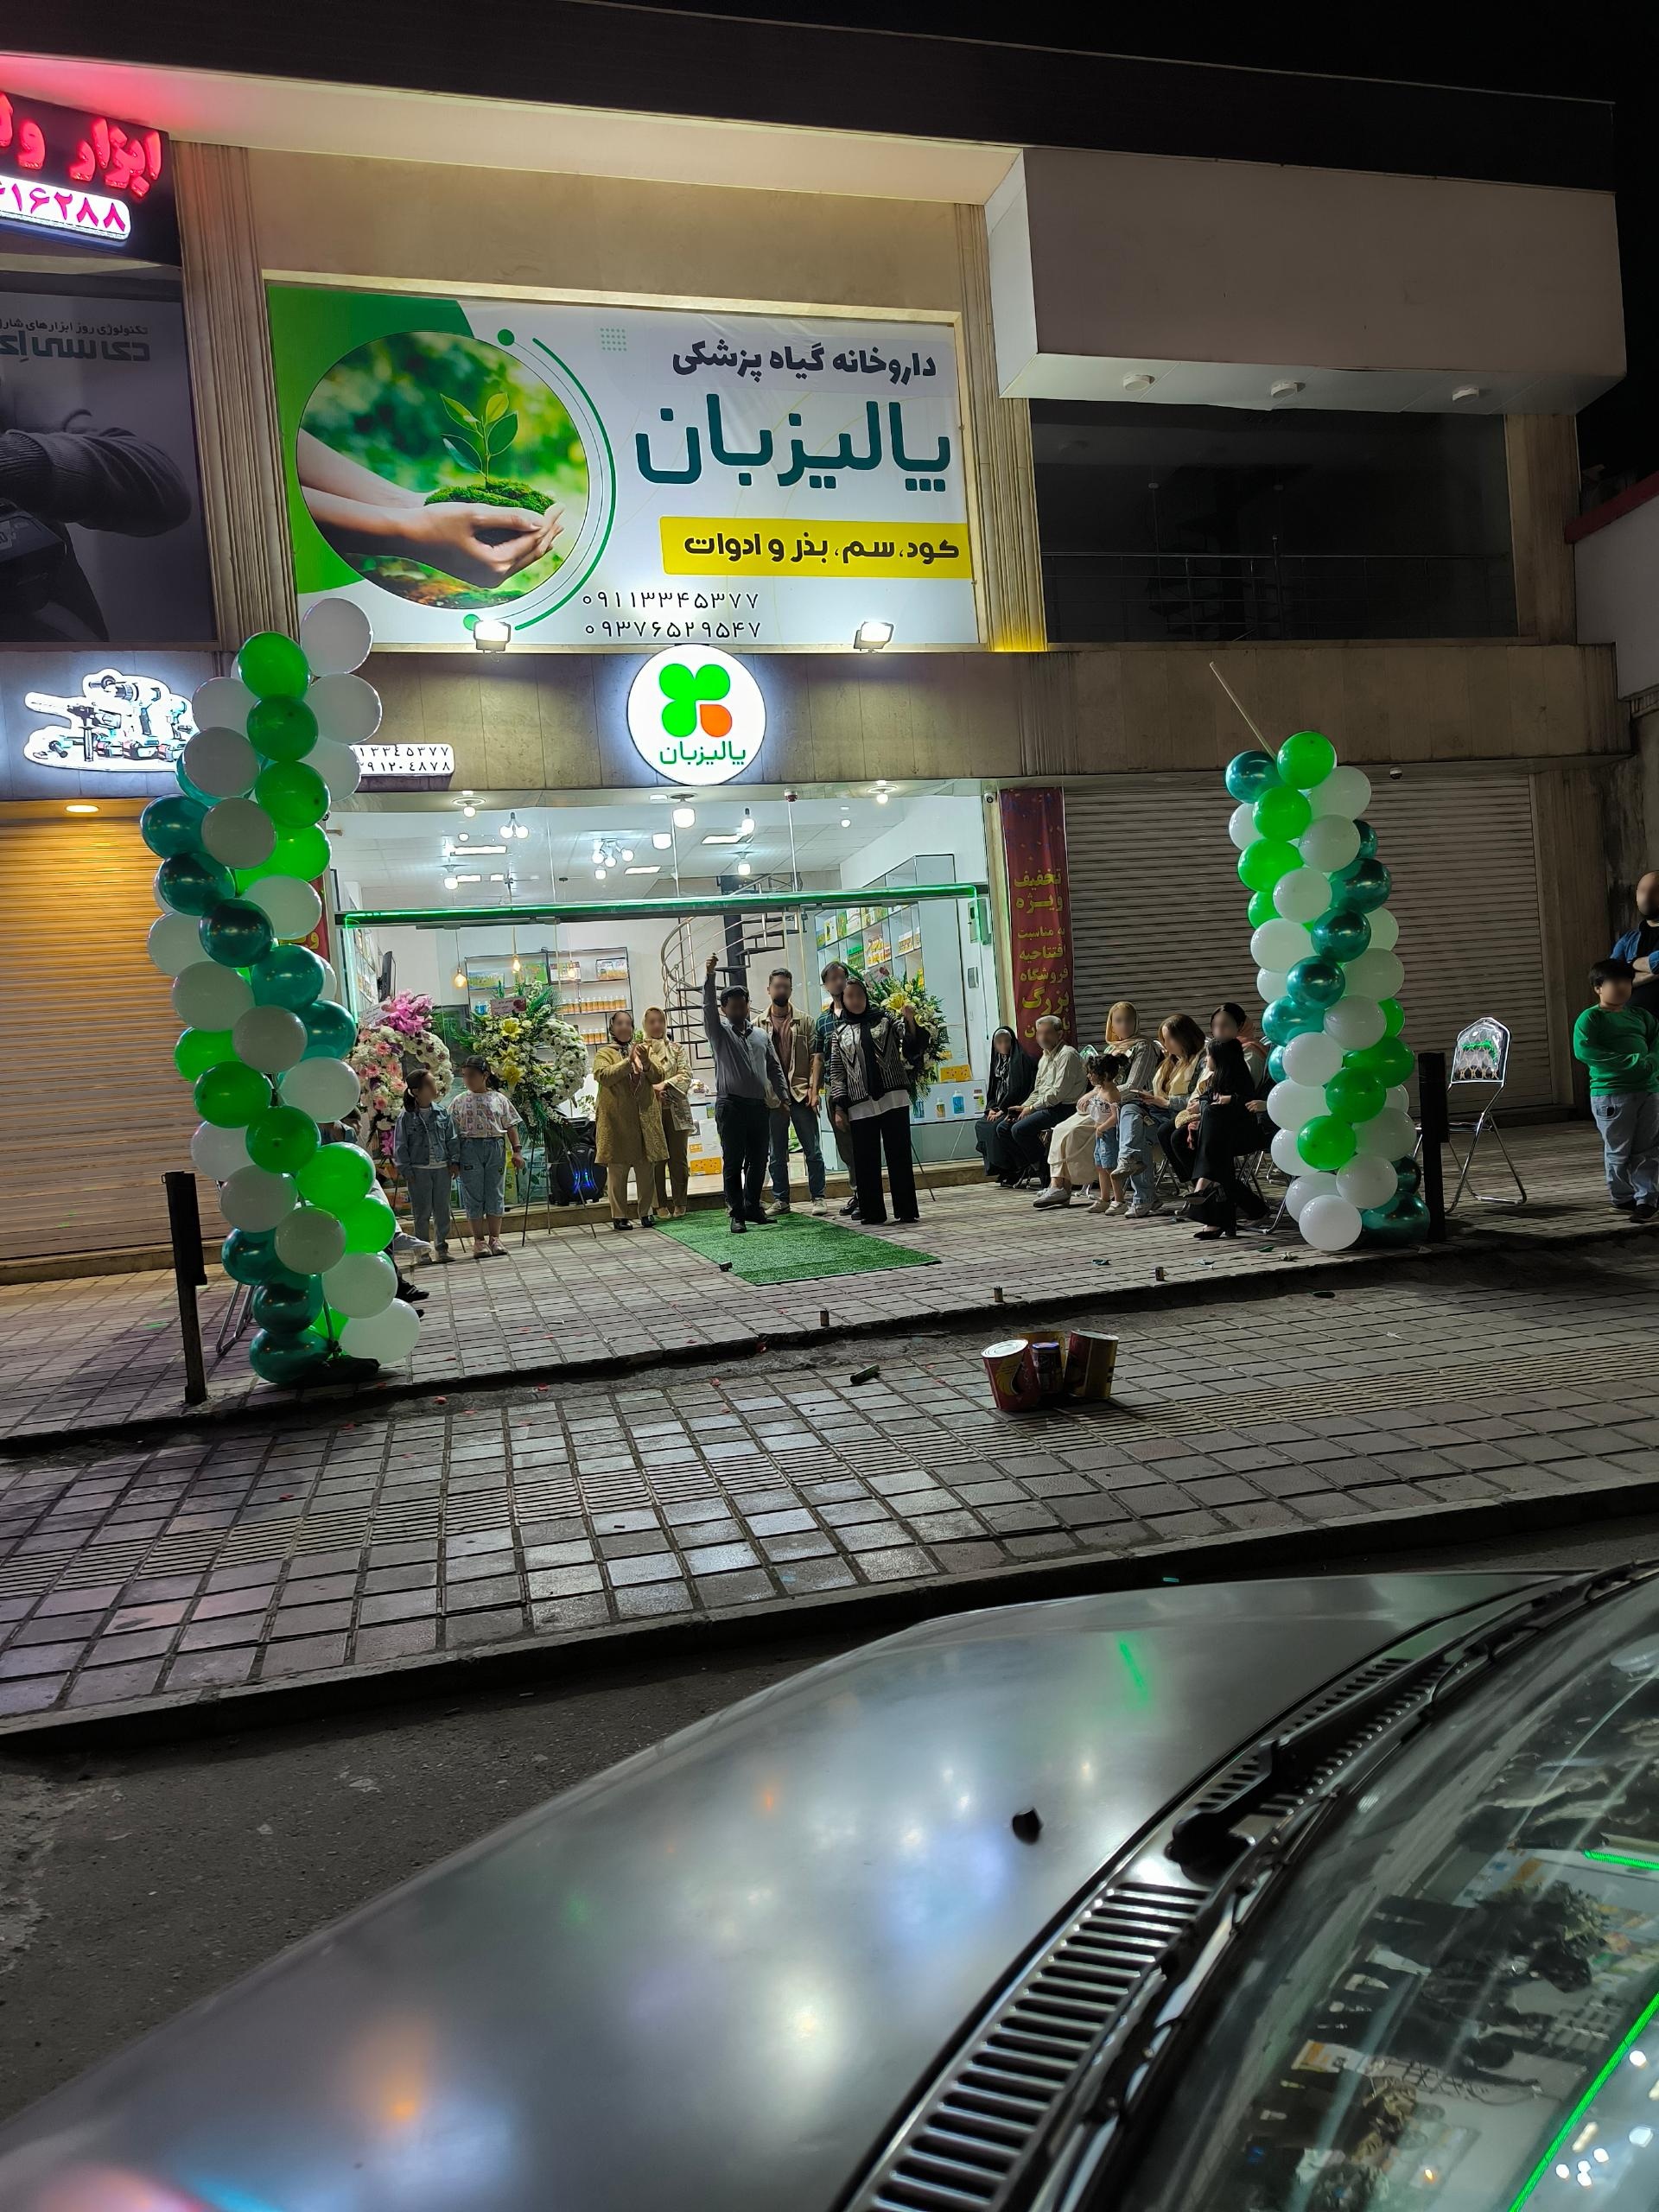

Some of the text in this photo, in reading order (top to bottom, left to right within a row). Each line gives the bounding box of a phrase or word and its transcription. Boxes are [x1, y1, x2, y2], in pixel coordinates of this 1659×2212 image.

[68, 118, 162, 198] ابزار
[76, 322, 94, 334] روز
[97, 323, 149, 336] تکنولوژی
[673, 339, 937, 385] داروخانه گیاه پزشکی
[635, 393, 950, 492] پالیزبان
[684, 532, 761, 562] ادوات
[768, 539, 785, 563] و
[791, 532, 828, 563] بذر
[582, 591, 759, 609] ۰۹۱۱۳۳۴۵۳۷۷
[585, 620, 760, 639] ۰۹۳۷۶۵۲۹۵۴۷
[659, 741, 746, 766] پالیزبان
[1014, 868, 1062, 891] تخفیف
[1015, 893, 1064, 914] ویژه
[1018, 926, 1054, 941] مناسبت
[1019, 943, 1066, 963] افتتاحیه
[1020, 964, 1069, 984] فروشگاه
[1022, 986, 1070, 1015] بزرگ
